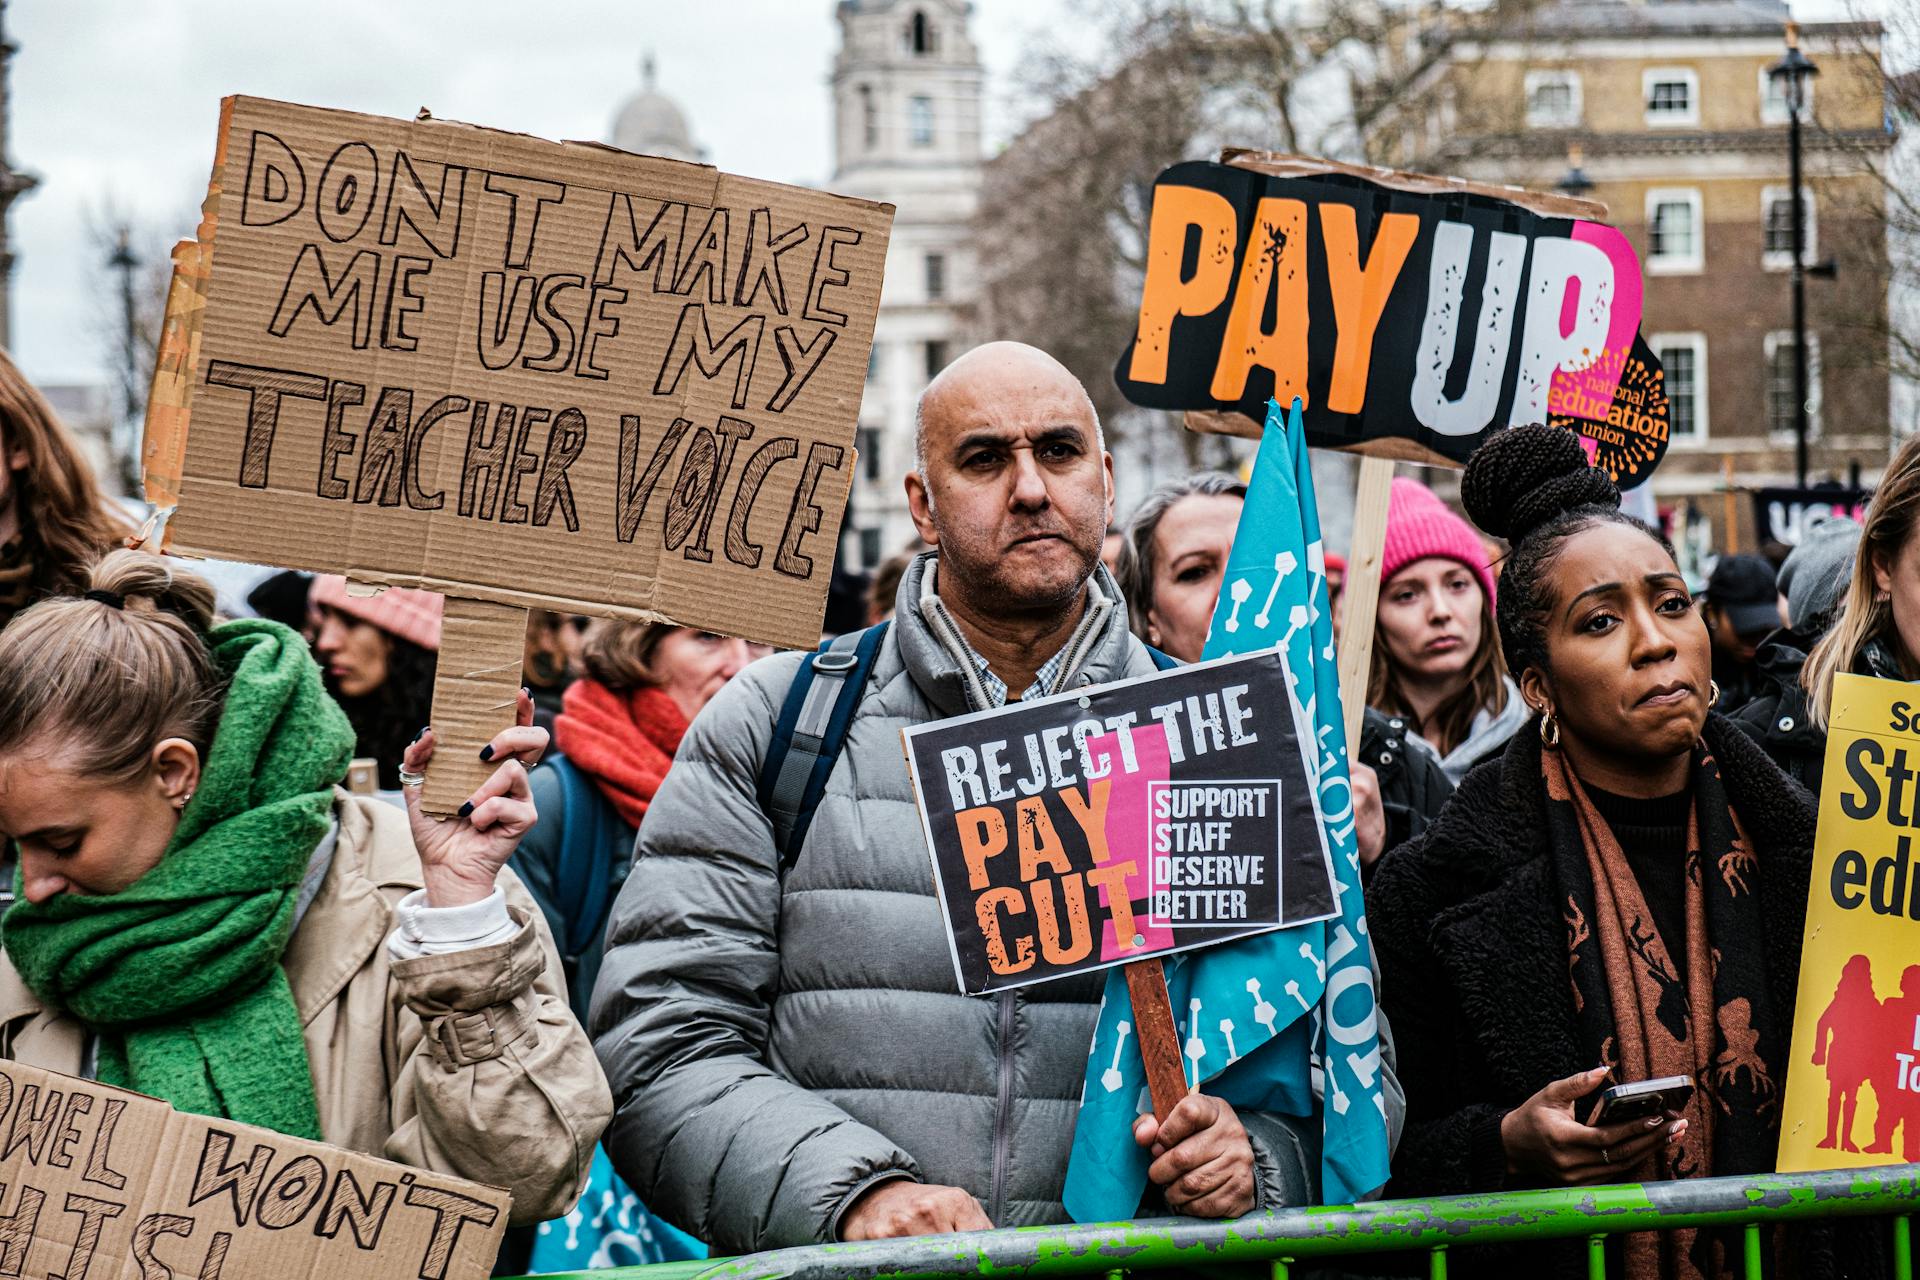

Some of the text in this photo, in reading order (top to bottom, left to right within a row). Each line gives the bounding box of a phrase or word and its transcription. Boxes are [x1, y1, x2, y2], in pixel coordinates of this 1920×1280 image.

[593, 192, 863, 326] MAKE
[1128, 184, 1615, 437] PAY UP
[268, 244, 837, 412] ME USE MY
[1547, 384, 1669, 442] education
[1581, 421, 1626, 447] union
[1585, 376, 1647, 407] national
[206, 360, 845, 579] TEACHER VOICE
[940, 683, 1259, 811] REJECT THE
[1154, 787, 1270, 819] SUPPORT
[955, 779, 1113, 891] PAY
[1154, 822, 1232, 854] STAFF
[1154, 855, 1265, 887] DESERVE
[974, 862, 1139, 976] CUT
[1154, 889, 1248, 921] BETTER
[188, 1127, 499, 1280] WON'T
